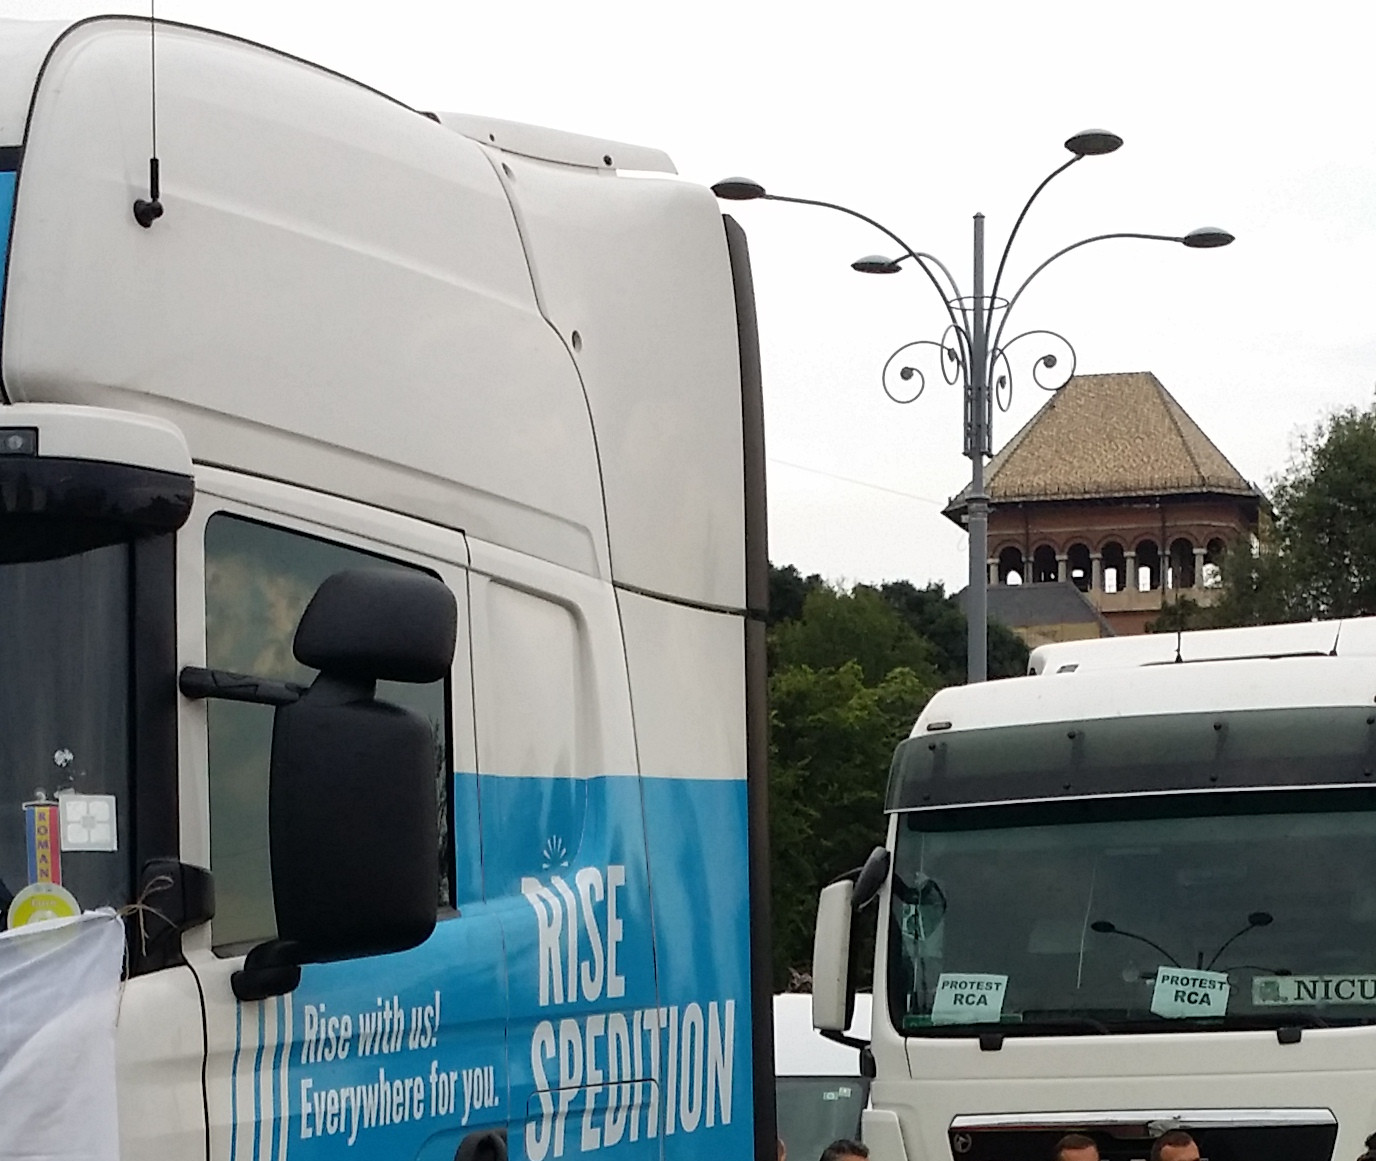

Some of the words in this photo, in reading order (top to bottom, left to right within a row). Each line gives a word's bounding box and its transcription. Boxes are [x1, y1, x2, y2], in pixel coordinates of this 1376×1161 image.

[522, 864, 626, 1006] RISE
[941, 980, 1003, 992] PROTEST
[1160, 974, 1227, 992] PROTEST
[952, 993, 988, 1006] RCA
[1173, 989, 1212, 1006] RCA
[300, 1001, 353, 1065] Rise
[357, 996, 406, 1058] with
[409, 990, 442, 1048] us!
[299, 1067, 425, 1147] Everywhere
[429, 1062, 459, 1118] for
[462, 1063, 500, 1127] you.
